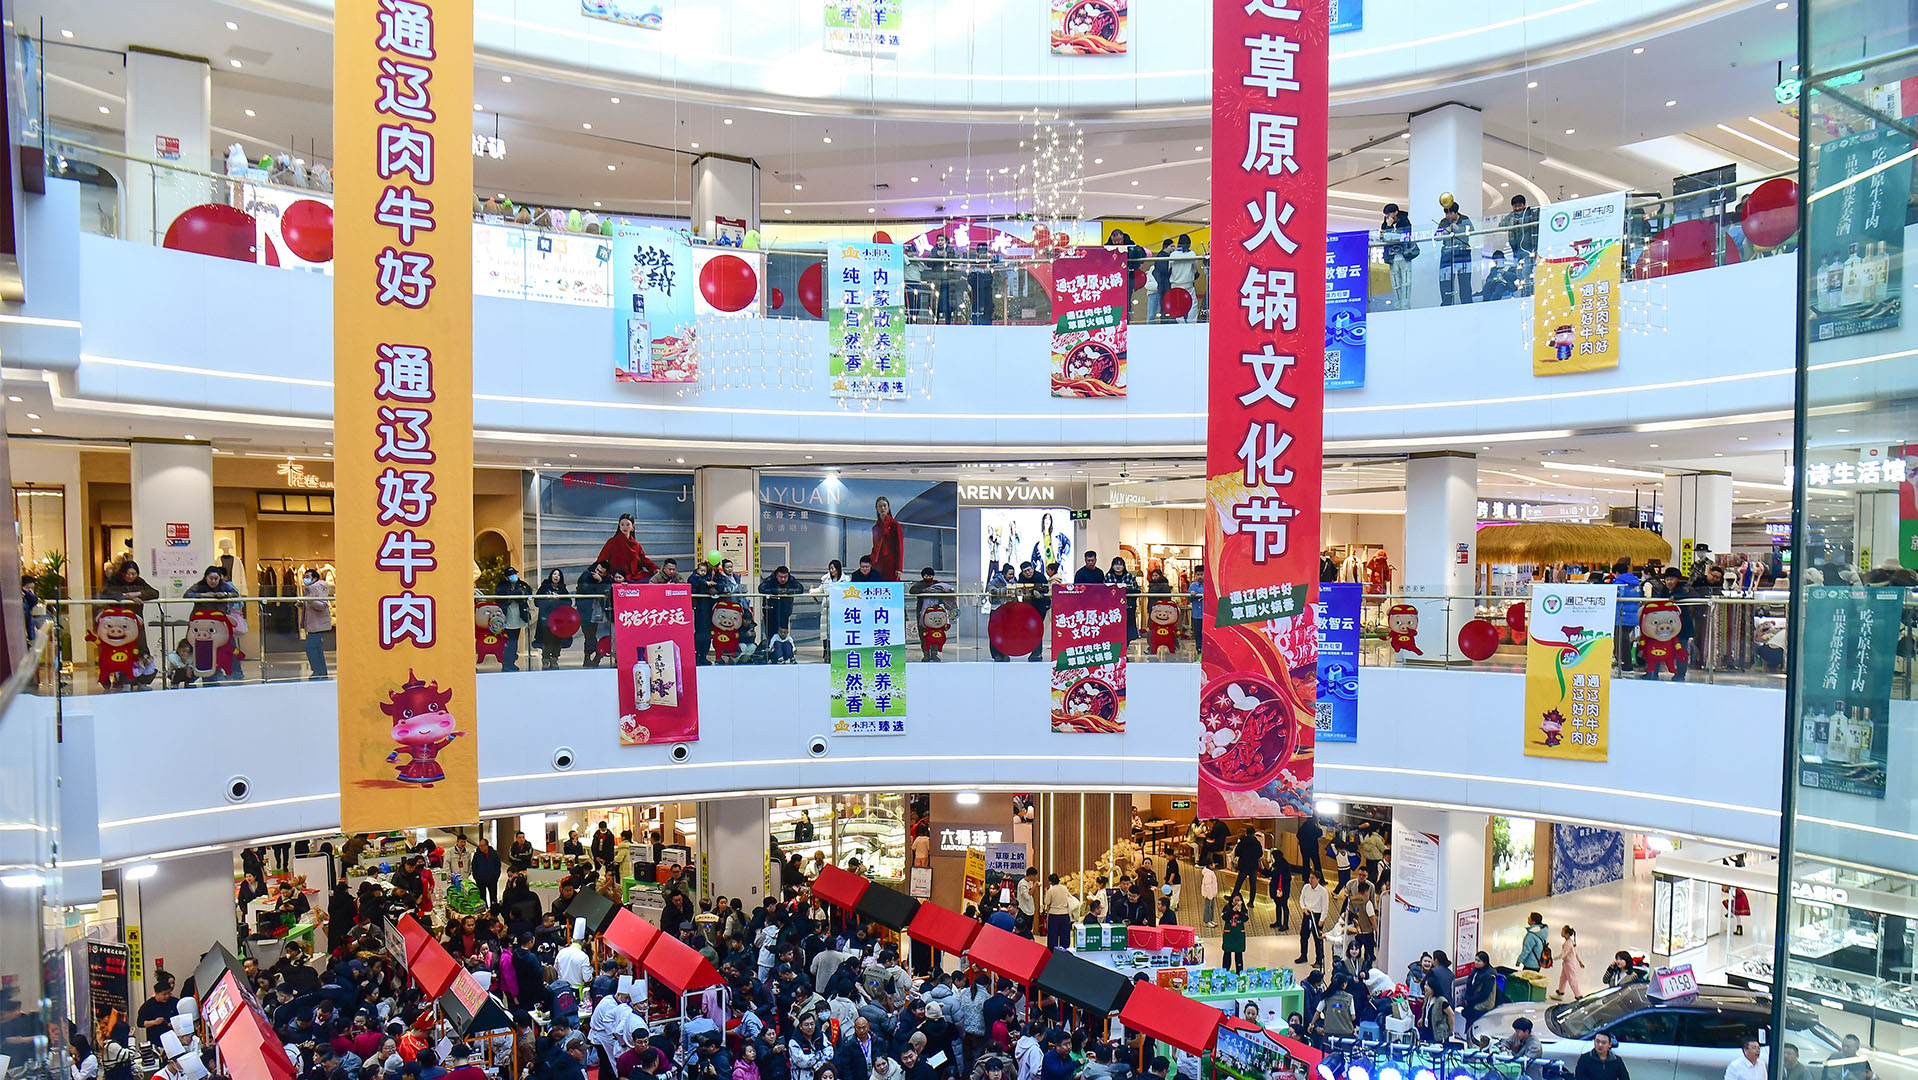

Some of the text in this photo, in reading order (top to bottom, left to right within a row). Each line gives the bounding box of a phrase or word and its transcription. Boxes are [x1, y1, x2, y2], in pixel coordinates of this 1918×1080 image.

[376, 0, 436, 308] 通辽肉牛好
[1056, 272, 1123, 293] 通辽草原火锅
[1073, 290, 1101, 304] 文化节
[843, 267, 862, 372] 纯正自然香
[873, 268, 891, 372] 内蒙散养羊
[1066, 305, 1112, 320] 通辽肉牛好
[1068, 316, 1114, 330] 草原火锅香
[1580, 283, 1595, 355] 通辽好牛肉
[1595, 281, 1610, 353] 通辽肉牛好
[375, 343, 436, 649] 通辽好牛肉
[1007, 485, 1054, 500] YUAN
[763, 511, 809, 520] 在骨子里
[1585, 504, 1600, 517] L2
[1229, 583, 1293, 605] 通辽肉牛好
[1564, 596, 1606, 606] 通辽牛肉
[1055, 608, 1122, 628] 通辽草原火锅
[1231, 598, 1295, 620] 草原火锅香
[1072, 626, 1100, 639] 文化节
[1066, 641, 1111, 656] 通辽肉牛好
[1067, 652, 1113, 666] 草原火锅香
[1851, 609, 1874, 693] 吃草原牛羊肉
[844, 607, 863, 713] 纯正自然香
[874, 607, 892, 712] 内蒙散养羊
[1571, 674, 1585, 745] 通辽好牛肉
[1586, 674, 1600, 746] 通辽肉牛好
[879, 720, 904, 732] 臻选
[995, 852, 1024, 860] 草原上的
[1792, 881, 1848, 902] CASIO
